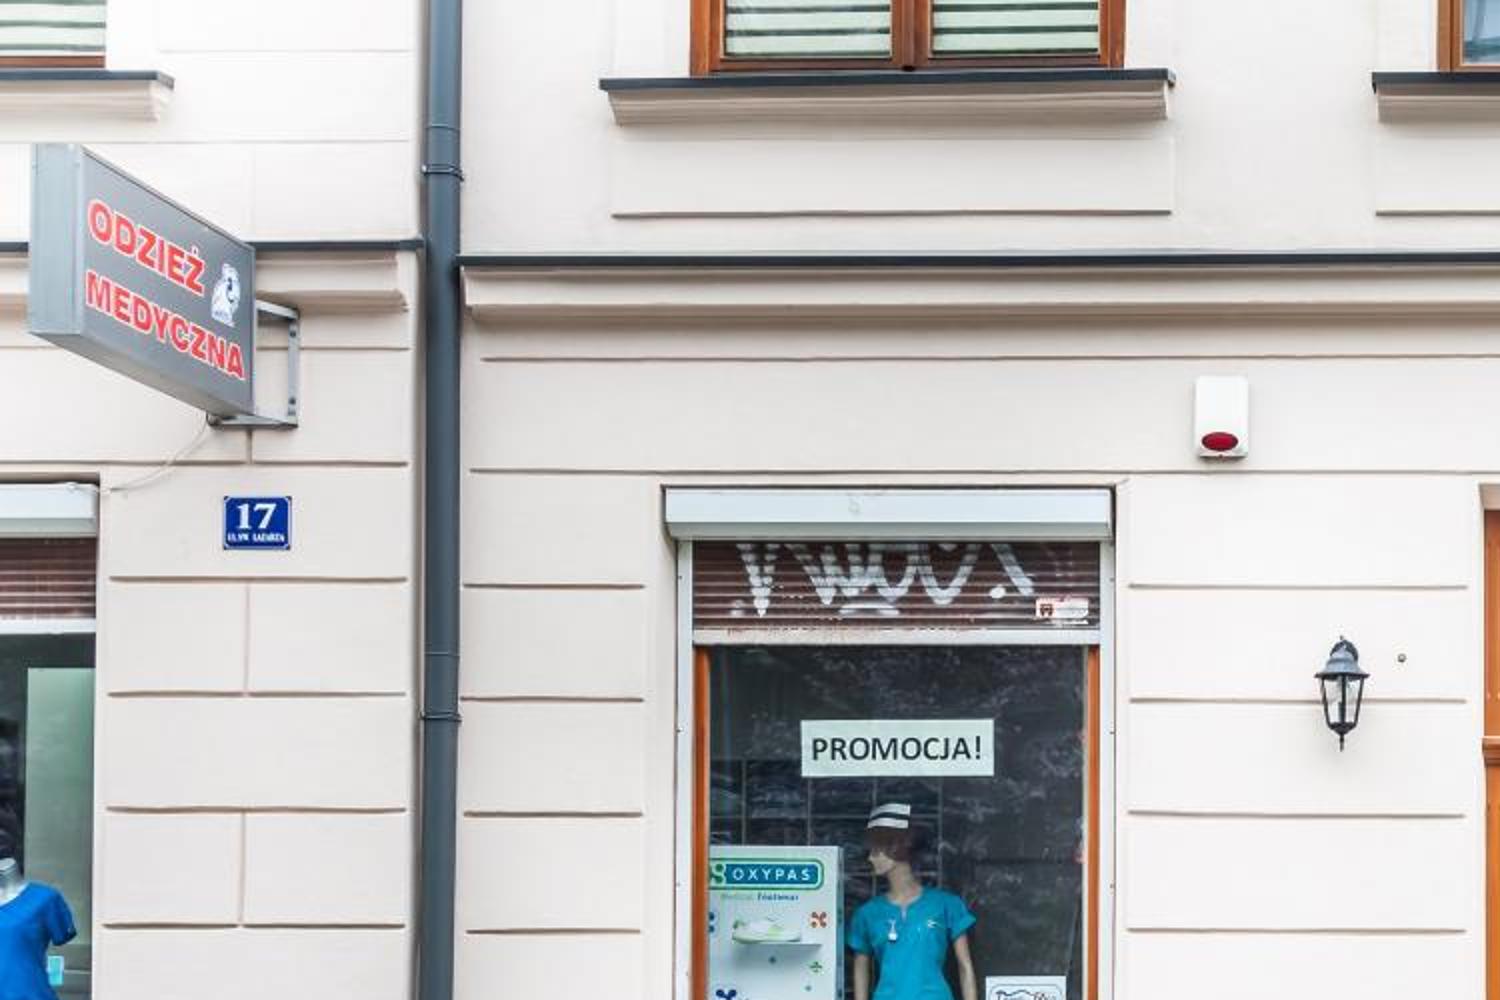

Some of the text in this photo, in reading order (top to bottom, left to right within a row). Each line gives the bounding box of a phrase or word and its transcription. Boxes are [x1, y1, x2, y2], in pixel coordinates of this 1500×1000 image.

[88, 200, 205, 295] ODZIEŻ
[86, 270, 245, 380] MEDYCZNA
[237, 503, 276, 529] 17
[811, 737, 982, 761] PROMOCJA!
[732, 867, 810, 881] OXYPAS
